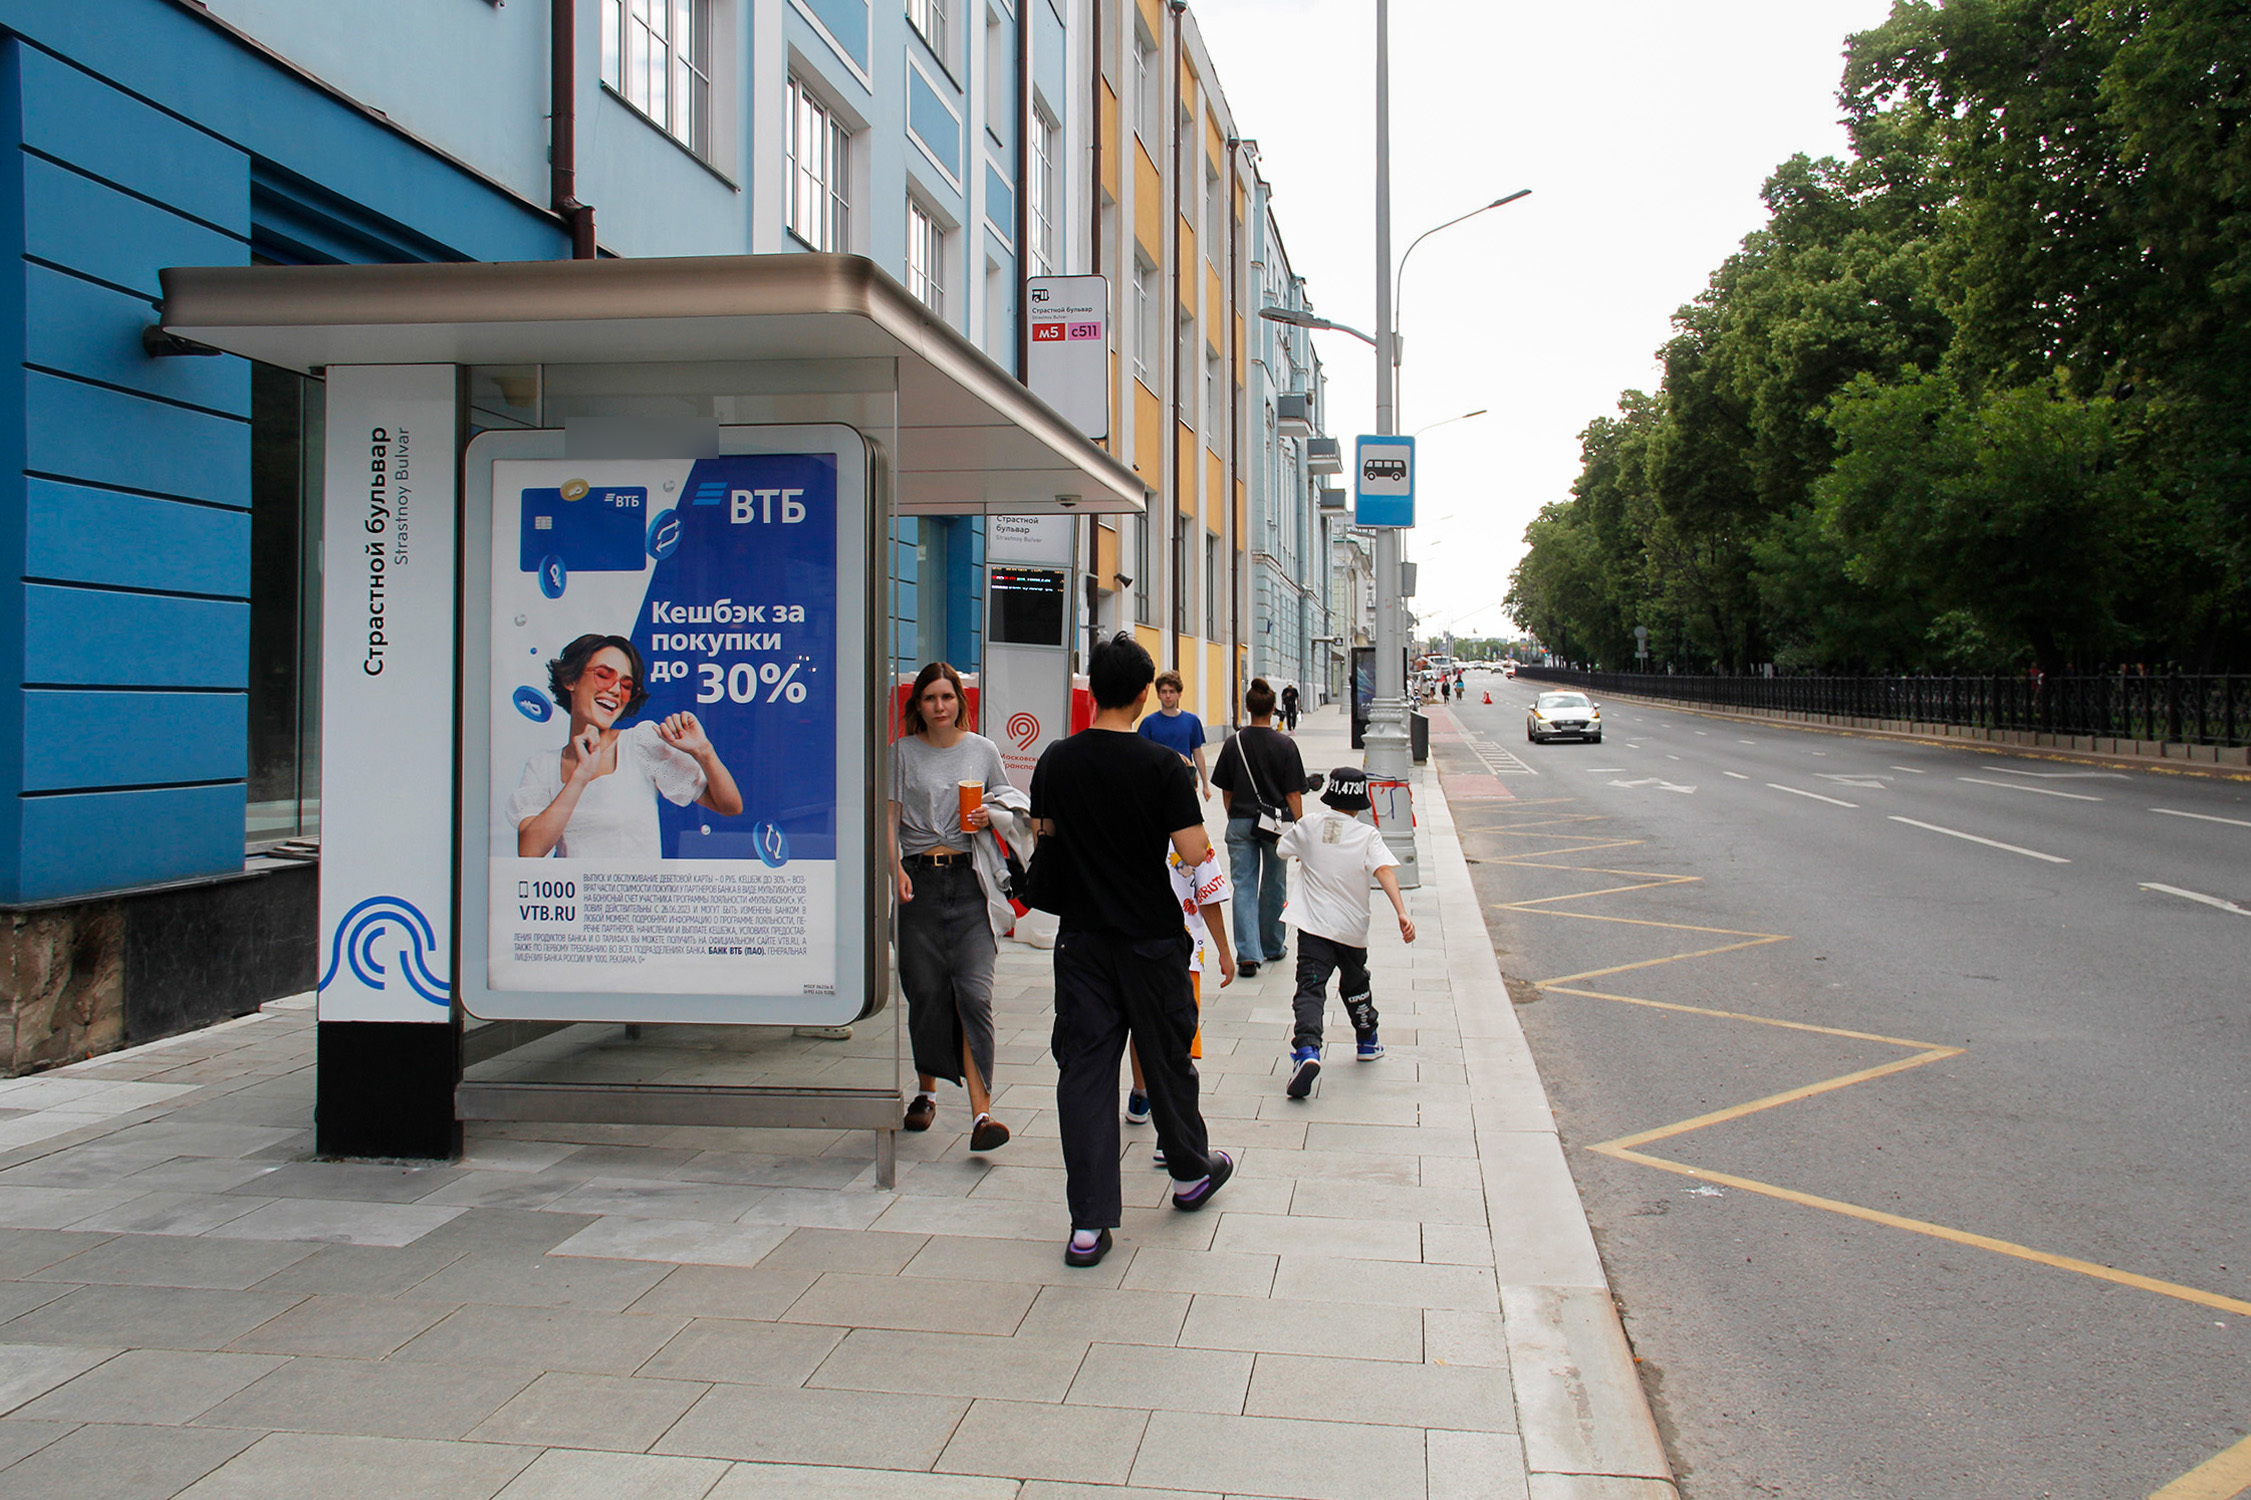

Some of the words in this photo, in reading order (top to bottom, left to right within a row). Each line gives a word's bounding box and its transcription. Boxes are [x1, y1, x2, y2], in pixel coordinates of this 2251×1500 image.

[395, 427, 410, 481] Bulvar
[364, 427, 391, 534] бульвар
[616, 495, 640, 507] ВТБ
[730, 489, 806, 524] ВТБ
[395, 486, 412, 565] Strastnoy
[996, 515, 1039, 524] Страстной
[996, 524, 1030, 534] бульвар
[363, 541, 389, 676] Страстной
[652, 598, 766, 624] Кешбэк
[772, 604, 805, 623] за
[652, 632, 782, 657] покупки
[650, 661, 689, 682] до
[696, 662, 807, 704] 30%
[1003, 761, 1036, 770] ранспо
[533, 881, 575, 898] 1000
[520, 905, 575, 921] VTB.RU
[708, 946, 728, 955] БАНК
[730, 946, 743, 955] ВТБ
[744, 946, 766, 956] (ПАО).
